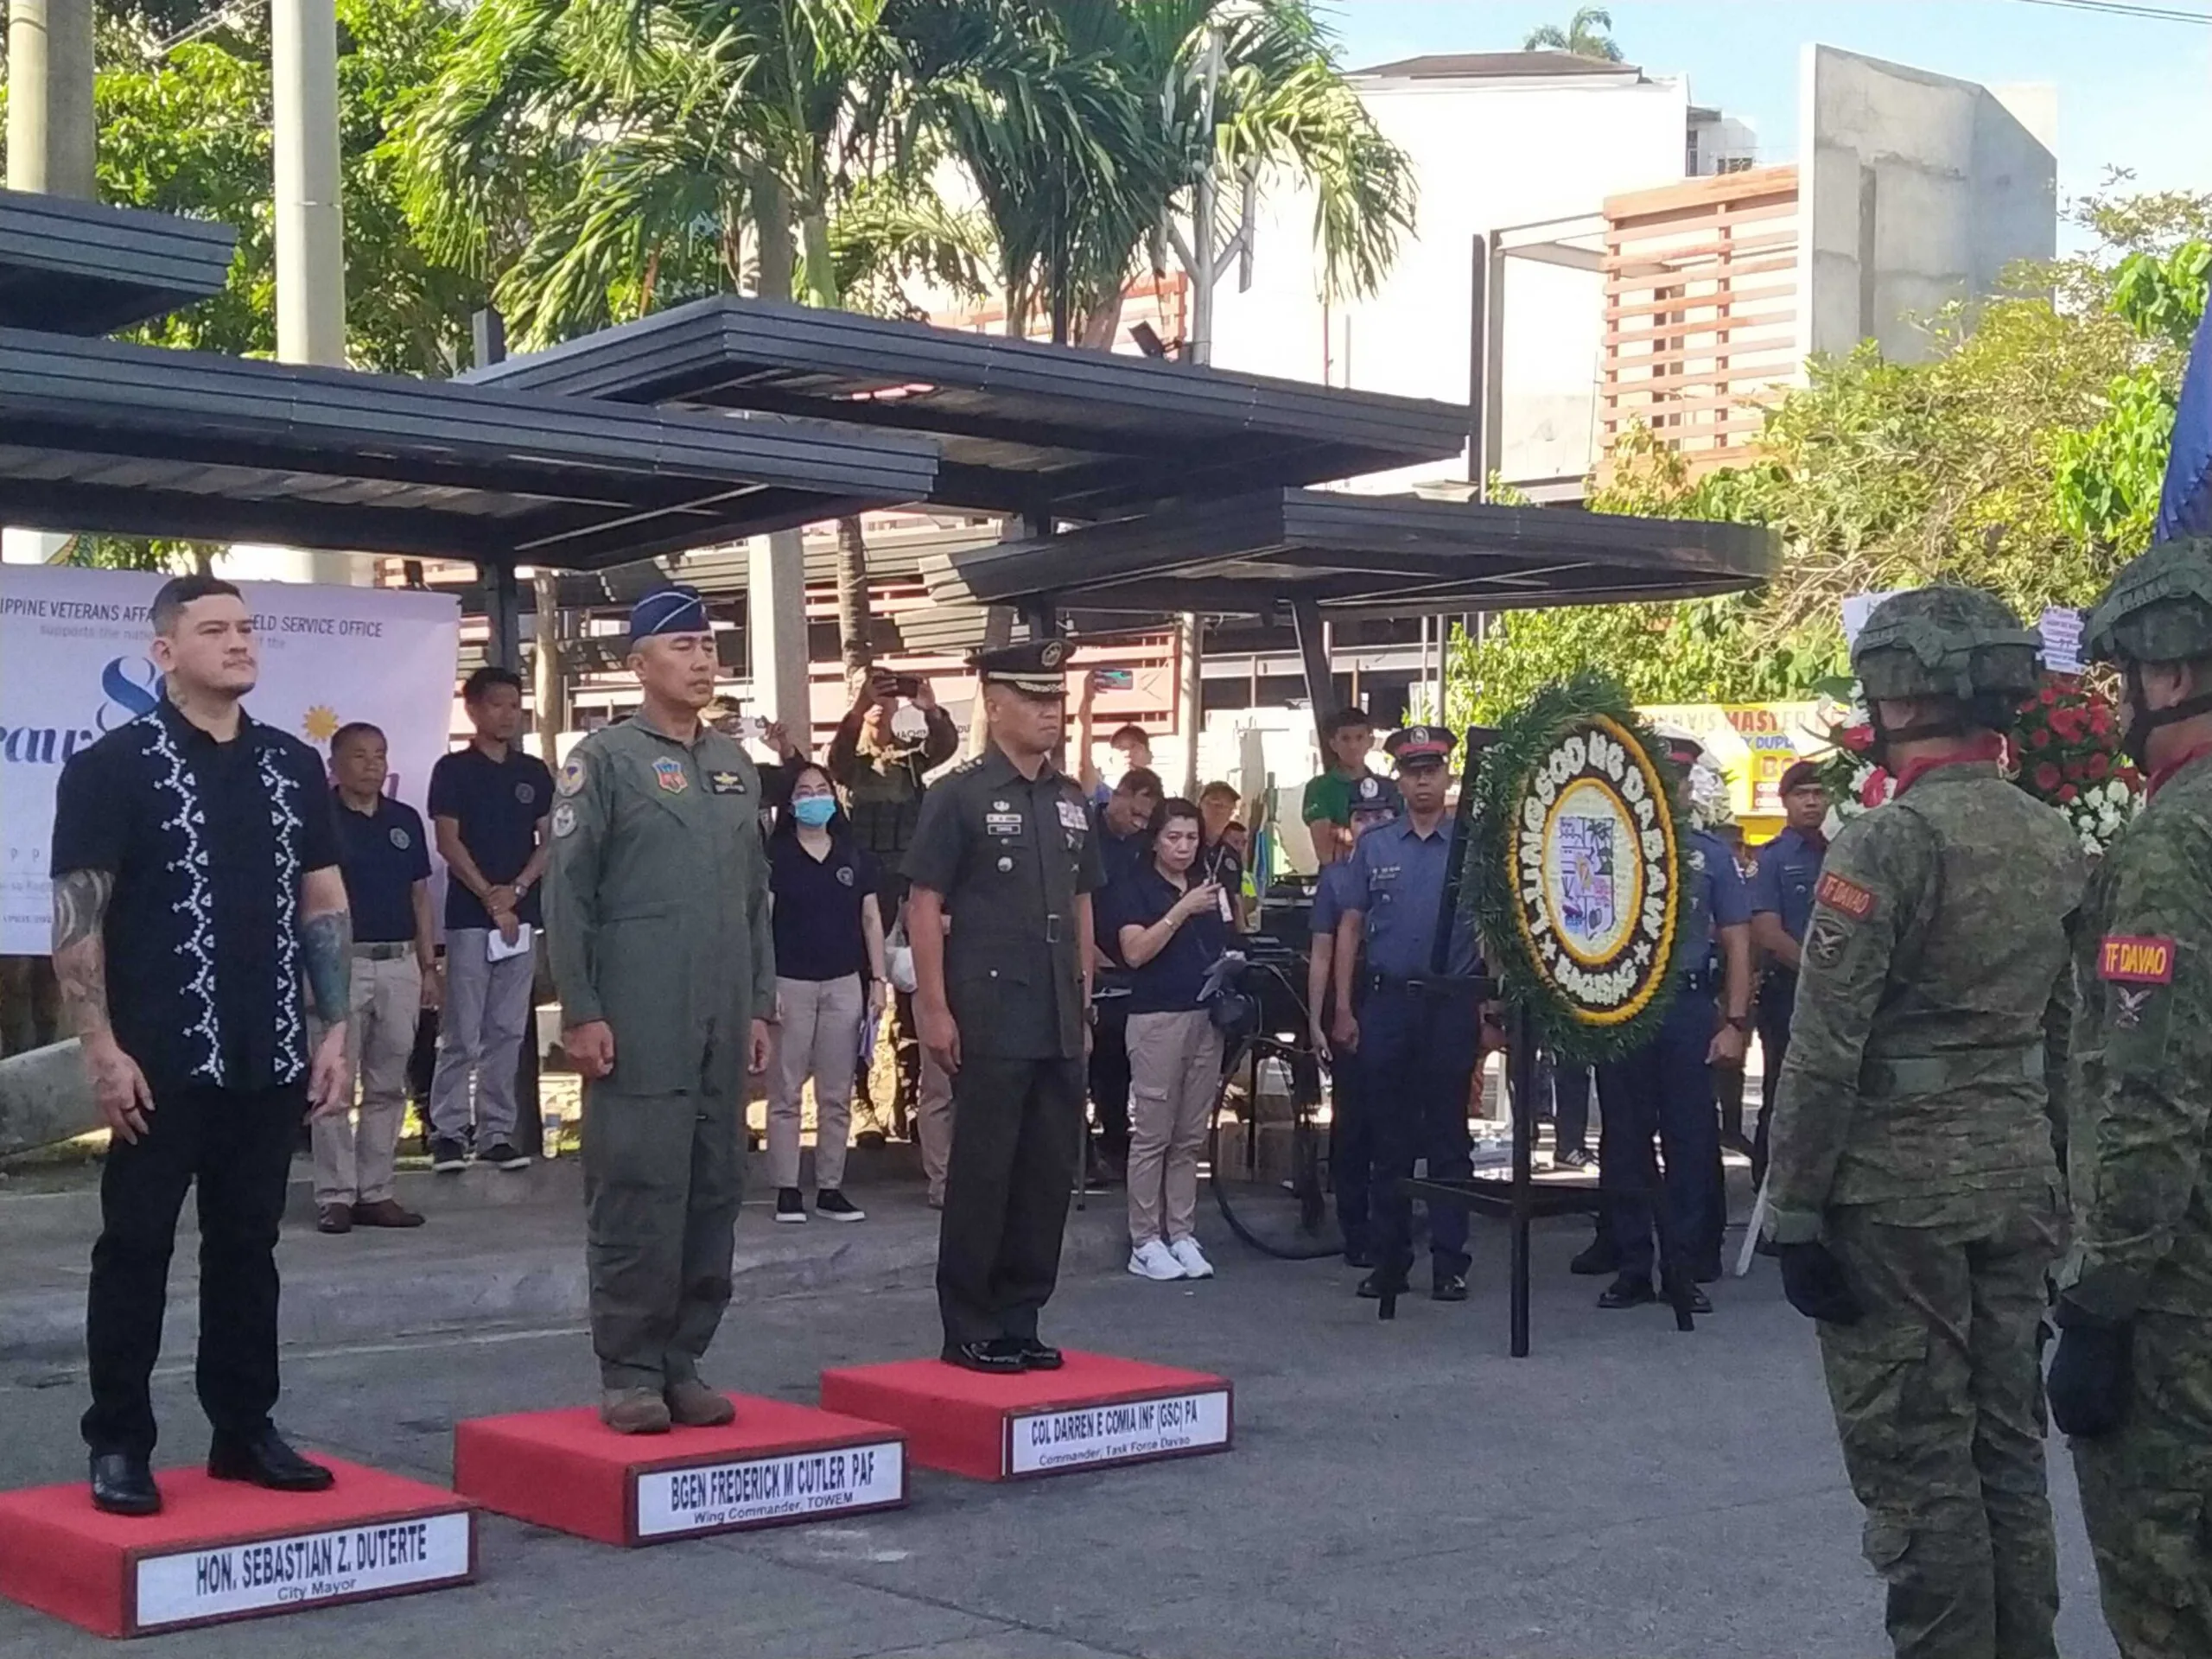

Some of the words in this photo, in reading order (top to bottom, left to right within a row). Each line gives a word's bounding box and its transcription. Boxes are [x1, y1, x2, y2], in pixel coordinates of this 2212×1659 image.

[50, 601, 119, 621] VETERANS
[281, 616, 335, 635] SERVICE
[339, 620, 383, 638] OFFICE
[1832, 881, 1870, 914] DAVAO
[2105, 943, 2120, 972] TF
[2120, 944, 2166, 976] DAVAO
[1031, 1421, 1052, 1446] COL
[1053, 1414, 1094, 1442] DARREN
[1096, 1411, 1103, 1436] E
[1106, 1408, 1136, 1434] COMIA
[1139, 1405, 1154, 1430] INF
[1157, 1402, 1183, 1433] (GSC)
[1185, 1399, 1198, 1423] PA
[1106, 1443, 1128, 1457] Task
[1130, 1439, 1158, 1452] Force
[1160, 1435, 1191, 1449] Davao
[671, 1473, 706, 1511] BGEN
[711, 1465, 780, 1505] FREDERICK
[784, 1462, 794, 1496] M
[798, 1455, 845, 1494] CUTLER
[852, 1451, 874, 1486] PAF
[694, 1510, 724, 1524] Wing
[808, 1491, 854, 1508] TOWEM
[196, 1553, 238, 1596] HON.
[242, 1537, 332, 1588] SEBASTIAN
[337, 1535, 352, 1573] Z.
[357, 1523, 427, 1571] DUTERTE
[277, 1585, 308, 1601] City
[311, 1577, 357, 1597] Mayor
